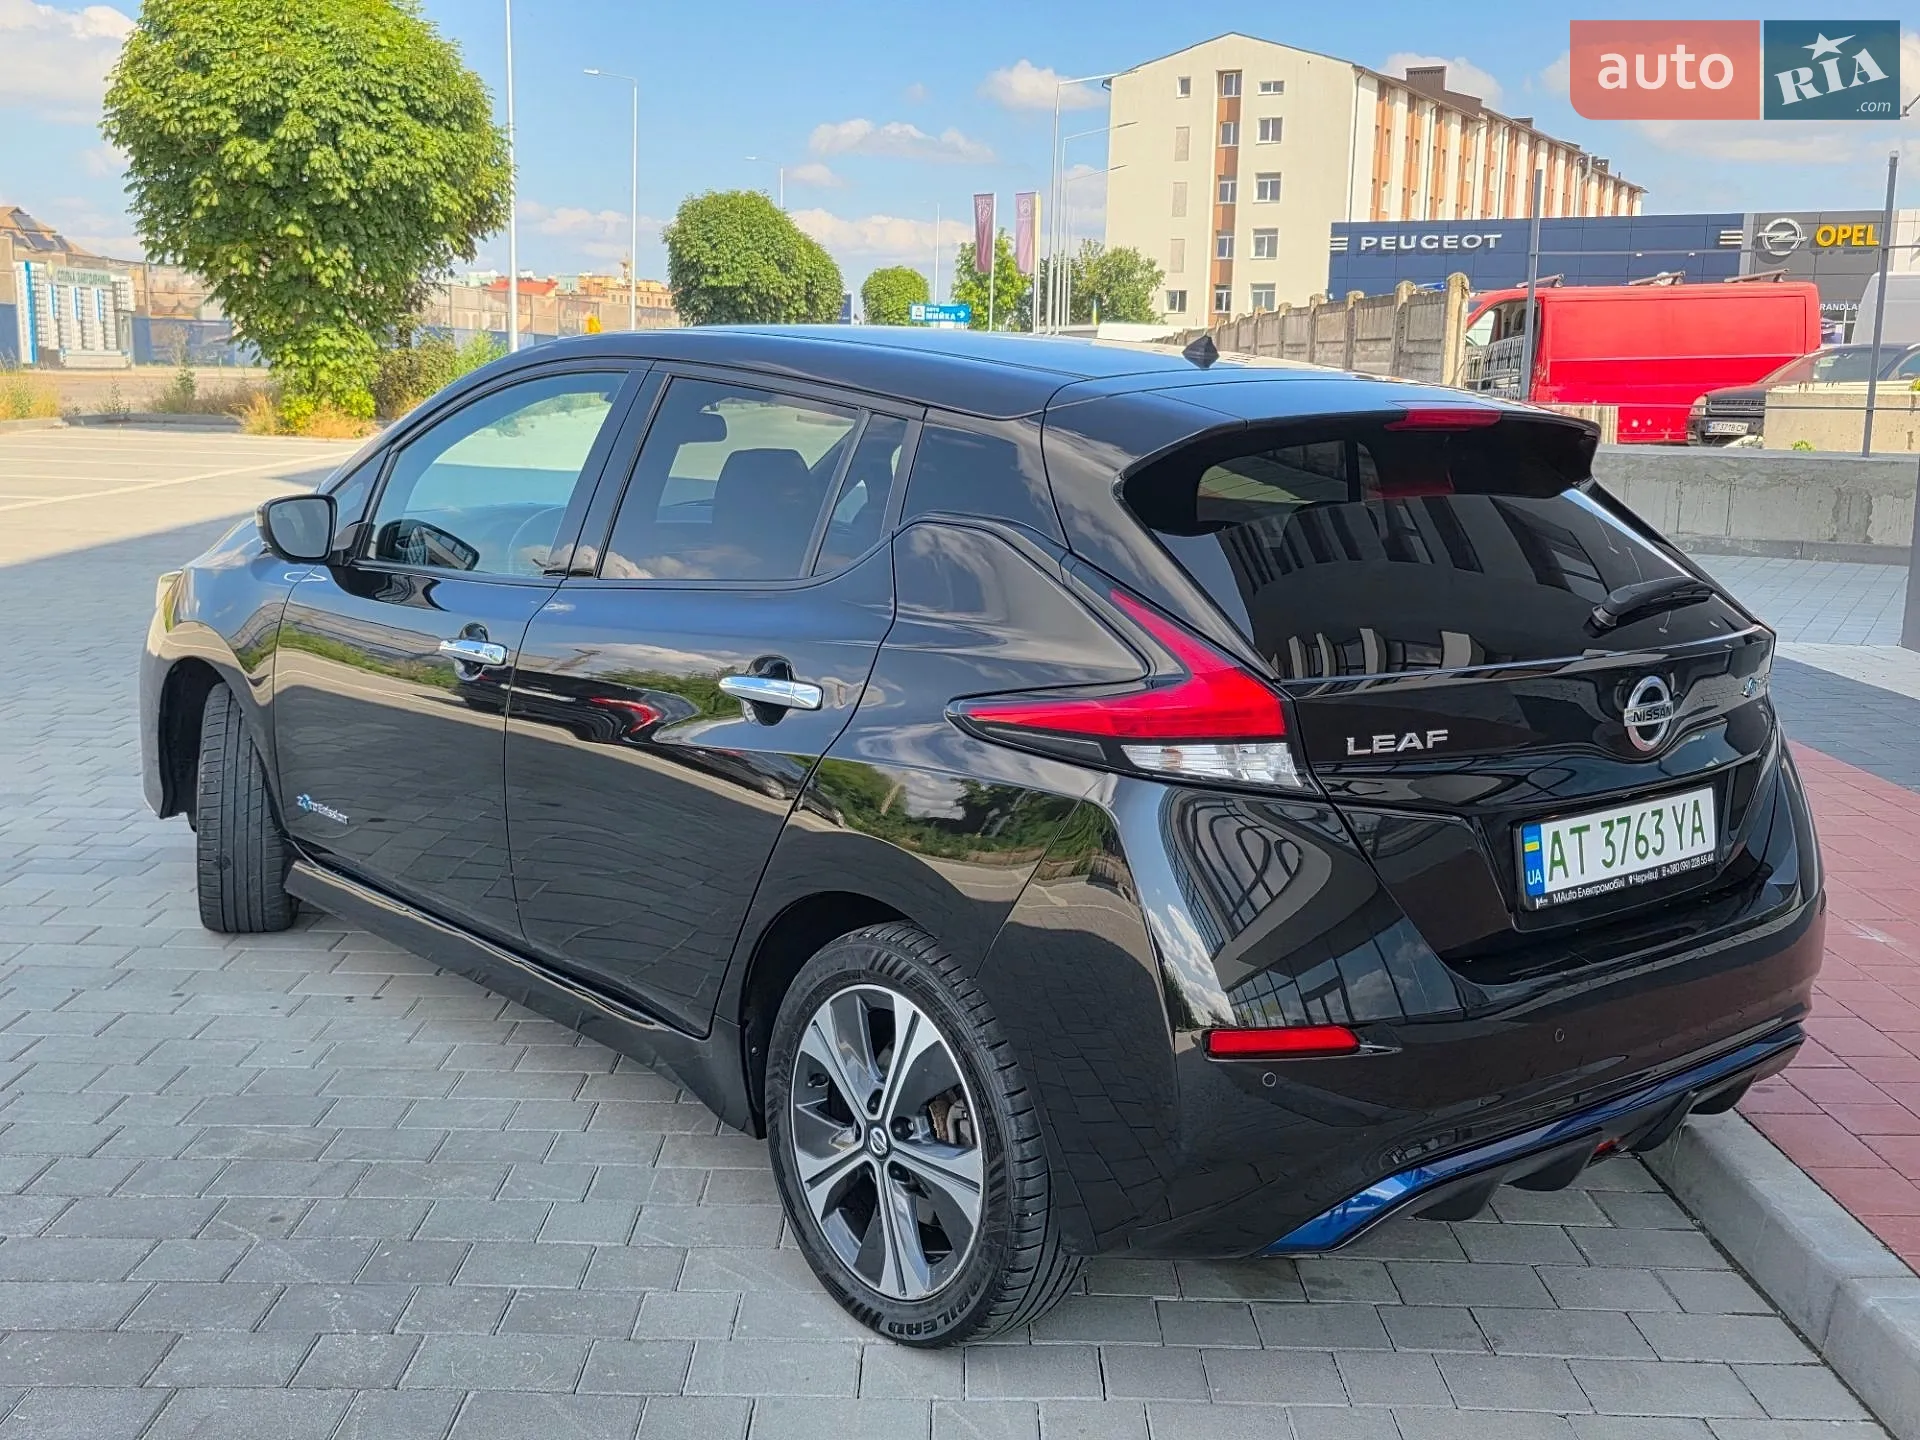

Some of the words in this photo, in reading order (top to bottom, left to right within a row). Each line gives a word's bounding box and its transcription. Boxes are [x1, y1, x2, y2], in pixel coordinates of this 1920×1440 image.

[1360, 233, 1502, 251] PEUGEOT
[1816, 224, 1879, 247] OPEL
[1632, 704, 1672, 723] NISSAN
[1346, 729, 1449, 756] LEAF
[1549, 824, 1591, 882] AT
[1600, 807, 1666, 869] 3763
[1672, 799, 1706, 851] YA
[1527, 869, 1543, 886] UA
